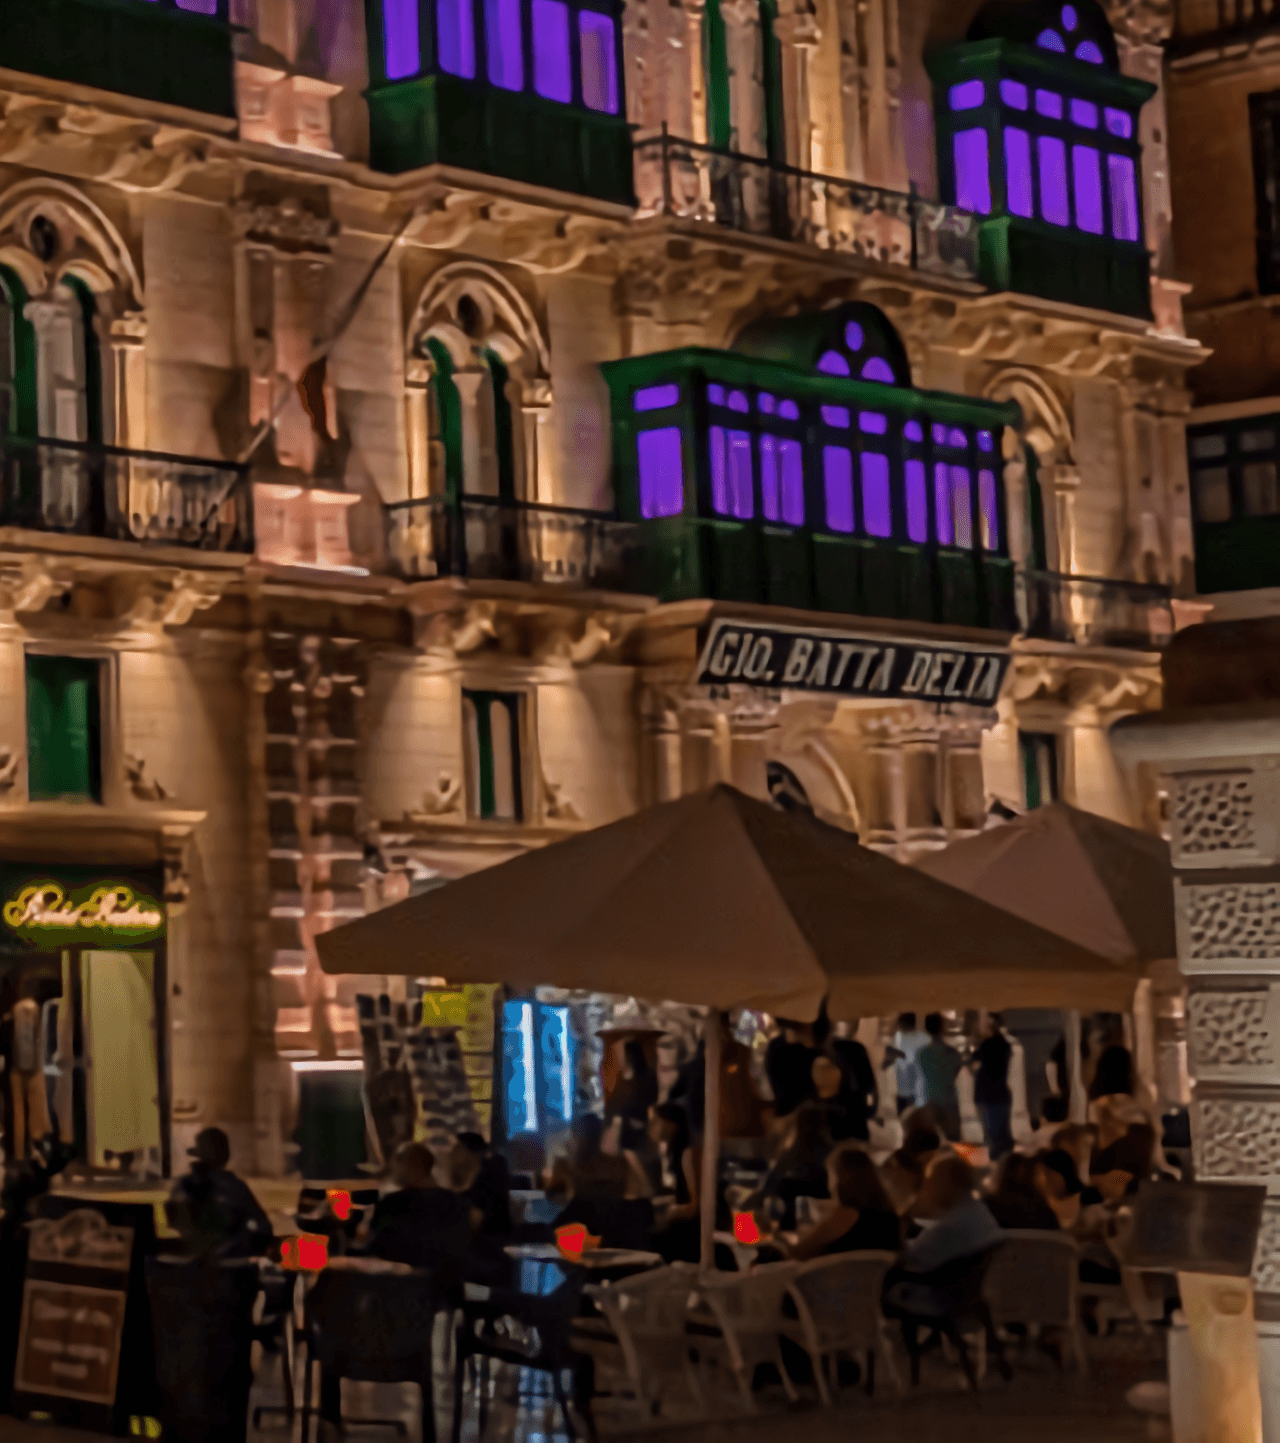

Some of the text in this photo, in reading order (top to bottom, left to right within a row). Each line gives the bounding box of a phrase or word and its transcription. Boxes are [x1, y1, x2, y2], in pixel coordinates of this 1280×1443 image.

[709, 632, 1000, 699] GIO. BATTA DELIA
